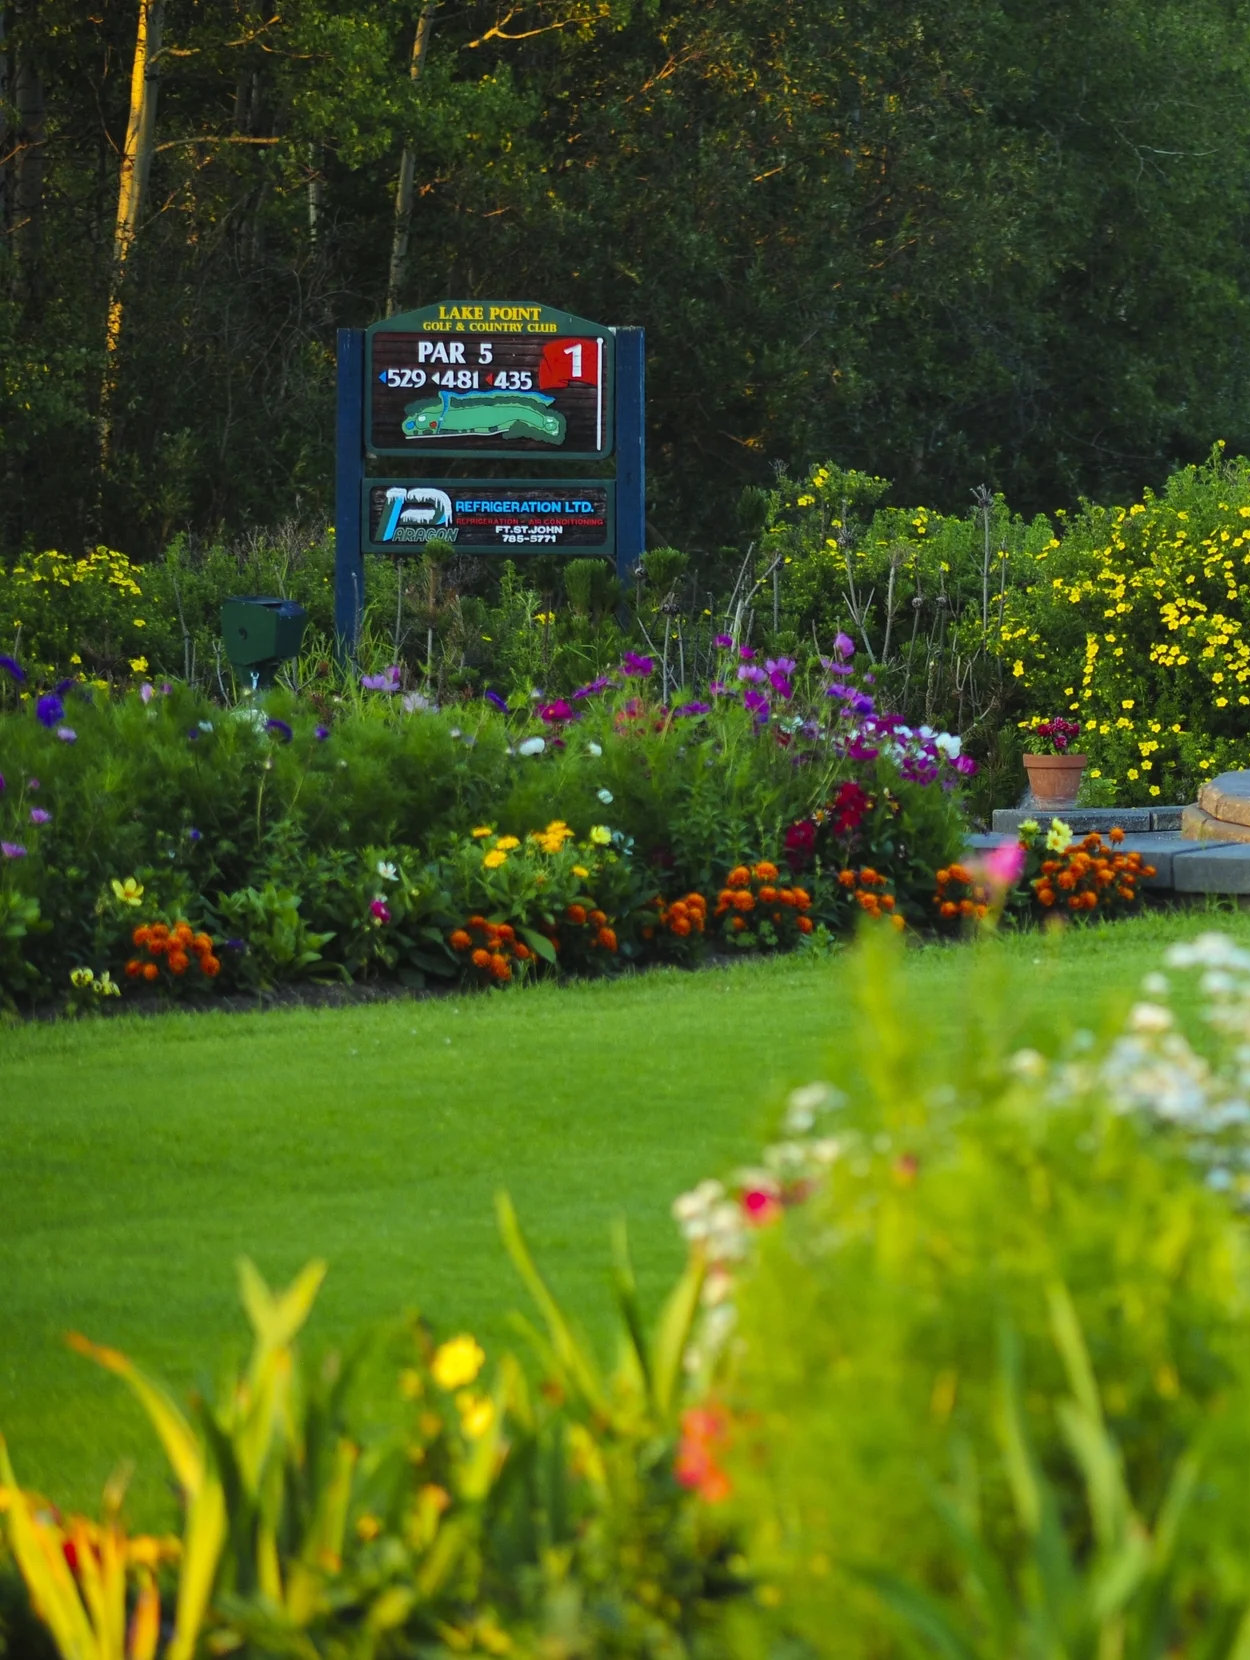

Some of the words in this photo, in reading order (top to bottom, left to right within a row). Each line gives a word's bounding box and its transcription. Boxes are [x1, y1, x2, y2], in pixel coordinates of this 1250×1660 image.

[439, 306, 484, 320] LAKE
[489, 307, 542, 321] POINT
[422, 322, 452, 331] GOLF
[455, 322, 465, 331] &
[469, 322, 523, 332] COUNTRY
[527, 323, 557, 333] CLUB
[418, 341, 466, 364] PAR
[478, 343, 493, 364] 5
[563, 343, 582, 378] 1
[387, 369, 427, 388] 529
[441, 370, 479, 389] 481
[494, 371, 532, 390] 435
[455, 500, 562, 513] REFRIGERATION
[565, 501, 595, 513] LTD.
[455, 517, 519, 525] REFRIGERATION
[543, 518, 604, 526] CONDITIONING
[502, 534, 557, 543] 785-5771
